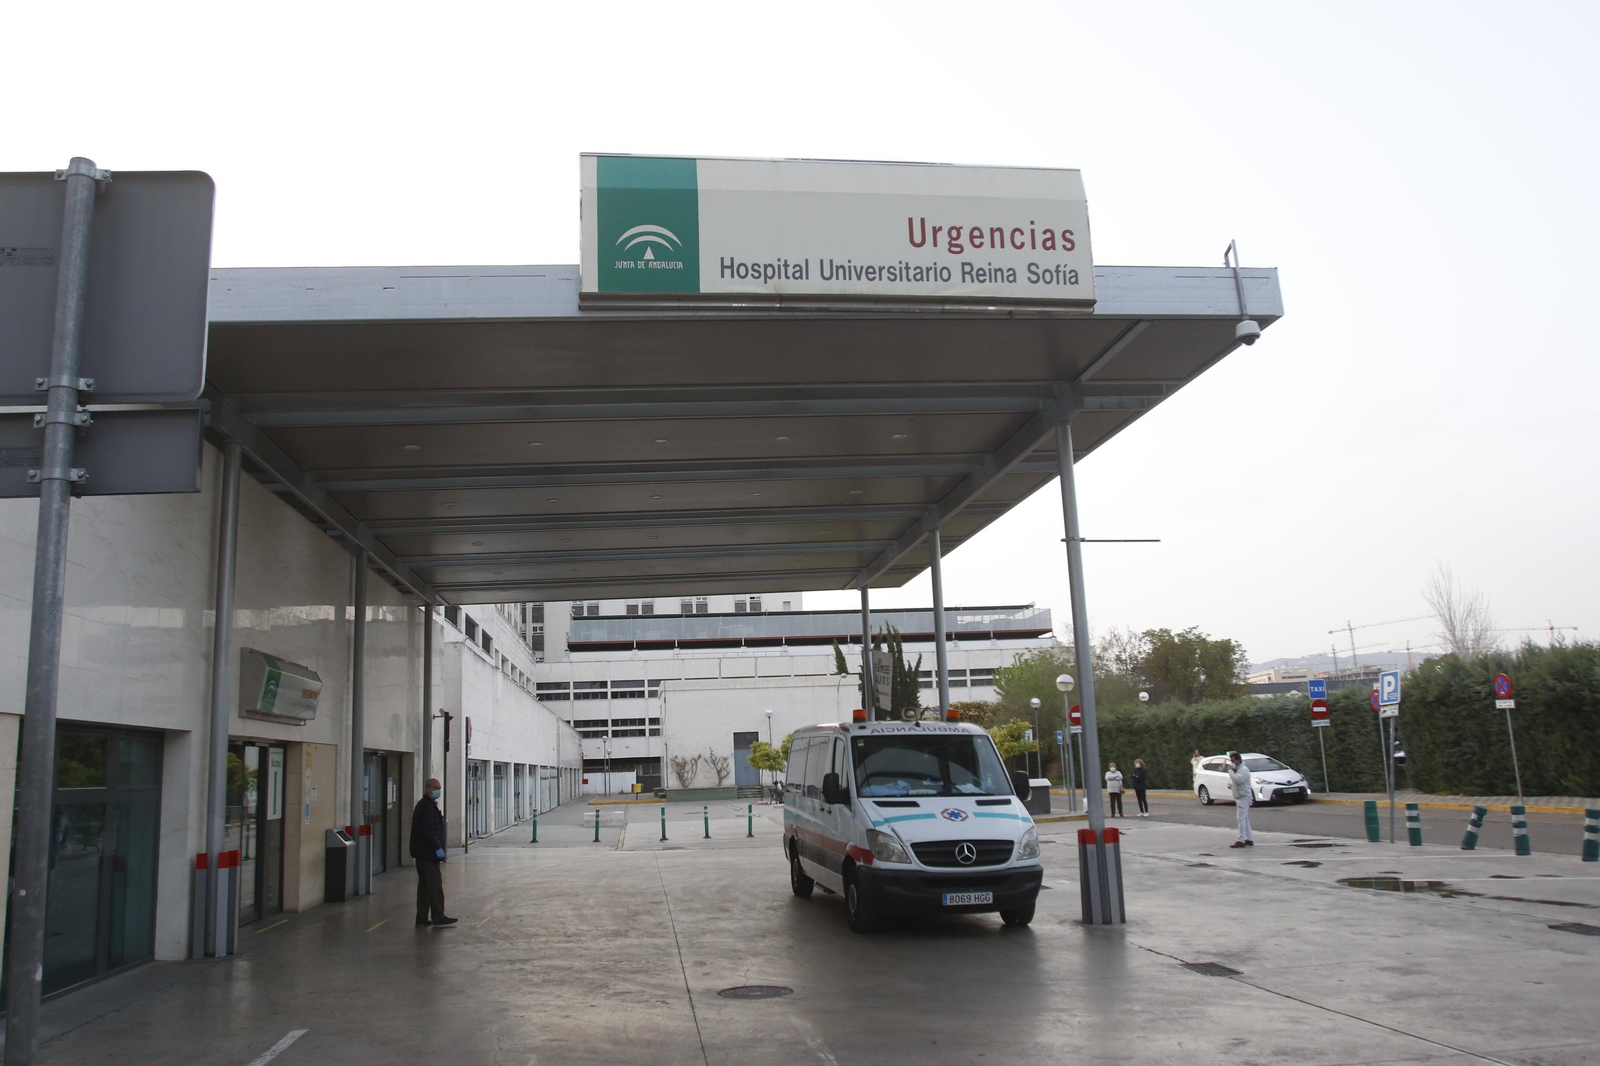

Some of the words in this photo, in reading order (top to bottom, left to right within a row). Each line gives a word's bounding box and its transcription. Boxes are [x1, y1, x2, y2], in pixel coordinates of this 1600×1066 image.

[908, 217, 1076, 255] Urgencias
[614, 261, 635, 269] JUNTA
[637, 261, 646, 269] DE
[648, 261, 684, 270] ANDALUCIA
[720, 256, 810, 284] Hospital
[819, 258, 952, 283] Universitario
[961, 261, 1017, 284] Reina
[1027, 261, 1080, 286] Sofía
[1383, 675, 1395, 700] P
[949, 894, 972, 904] 8069
[974, 893, 991, 903] HGG
